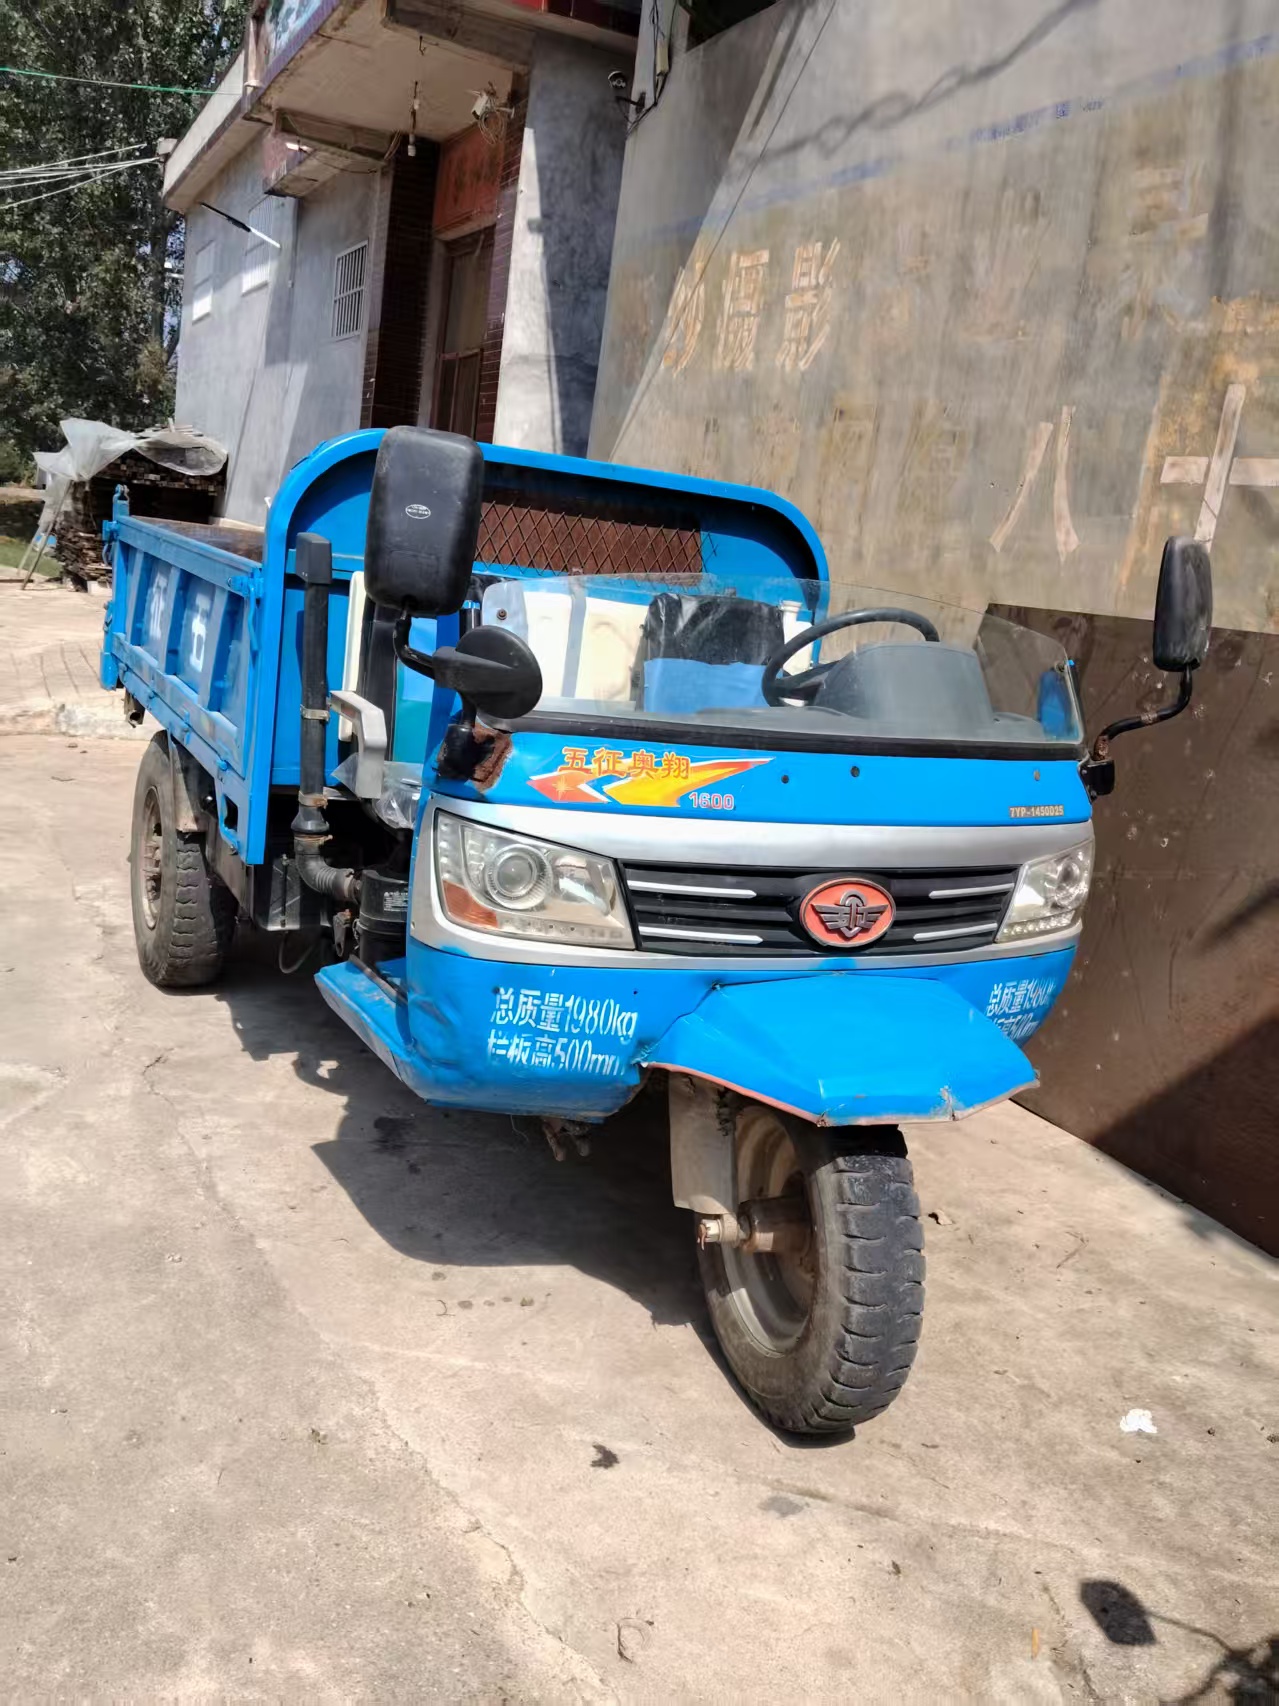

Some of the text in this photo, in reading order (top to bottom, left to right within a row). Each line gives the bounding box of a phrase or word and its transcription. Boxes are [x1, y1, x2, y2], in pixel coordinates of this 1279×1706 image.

[557, 746, 691, 779] 五征奥翔
[688, 791, 735, 810] 1600
[490, 986, 638, 1045] 总质量1980kg
